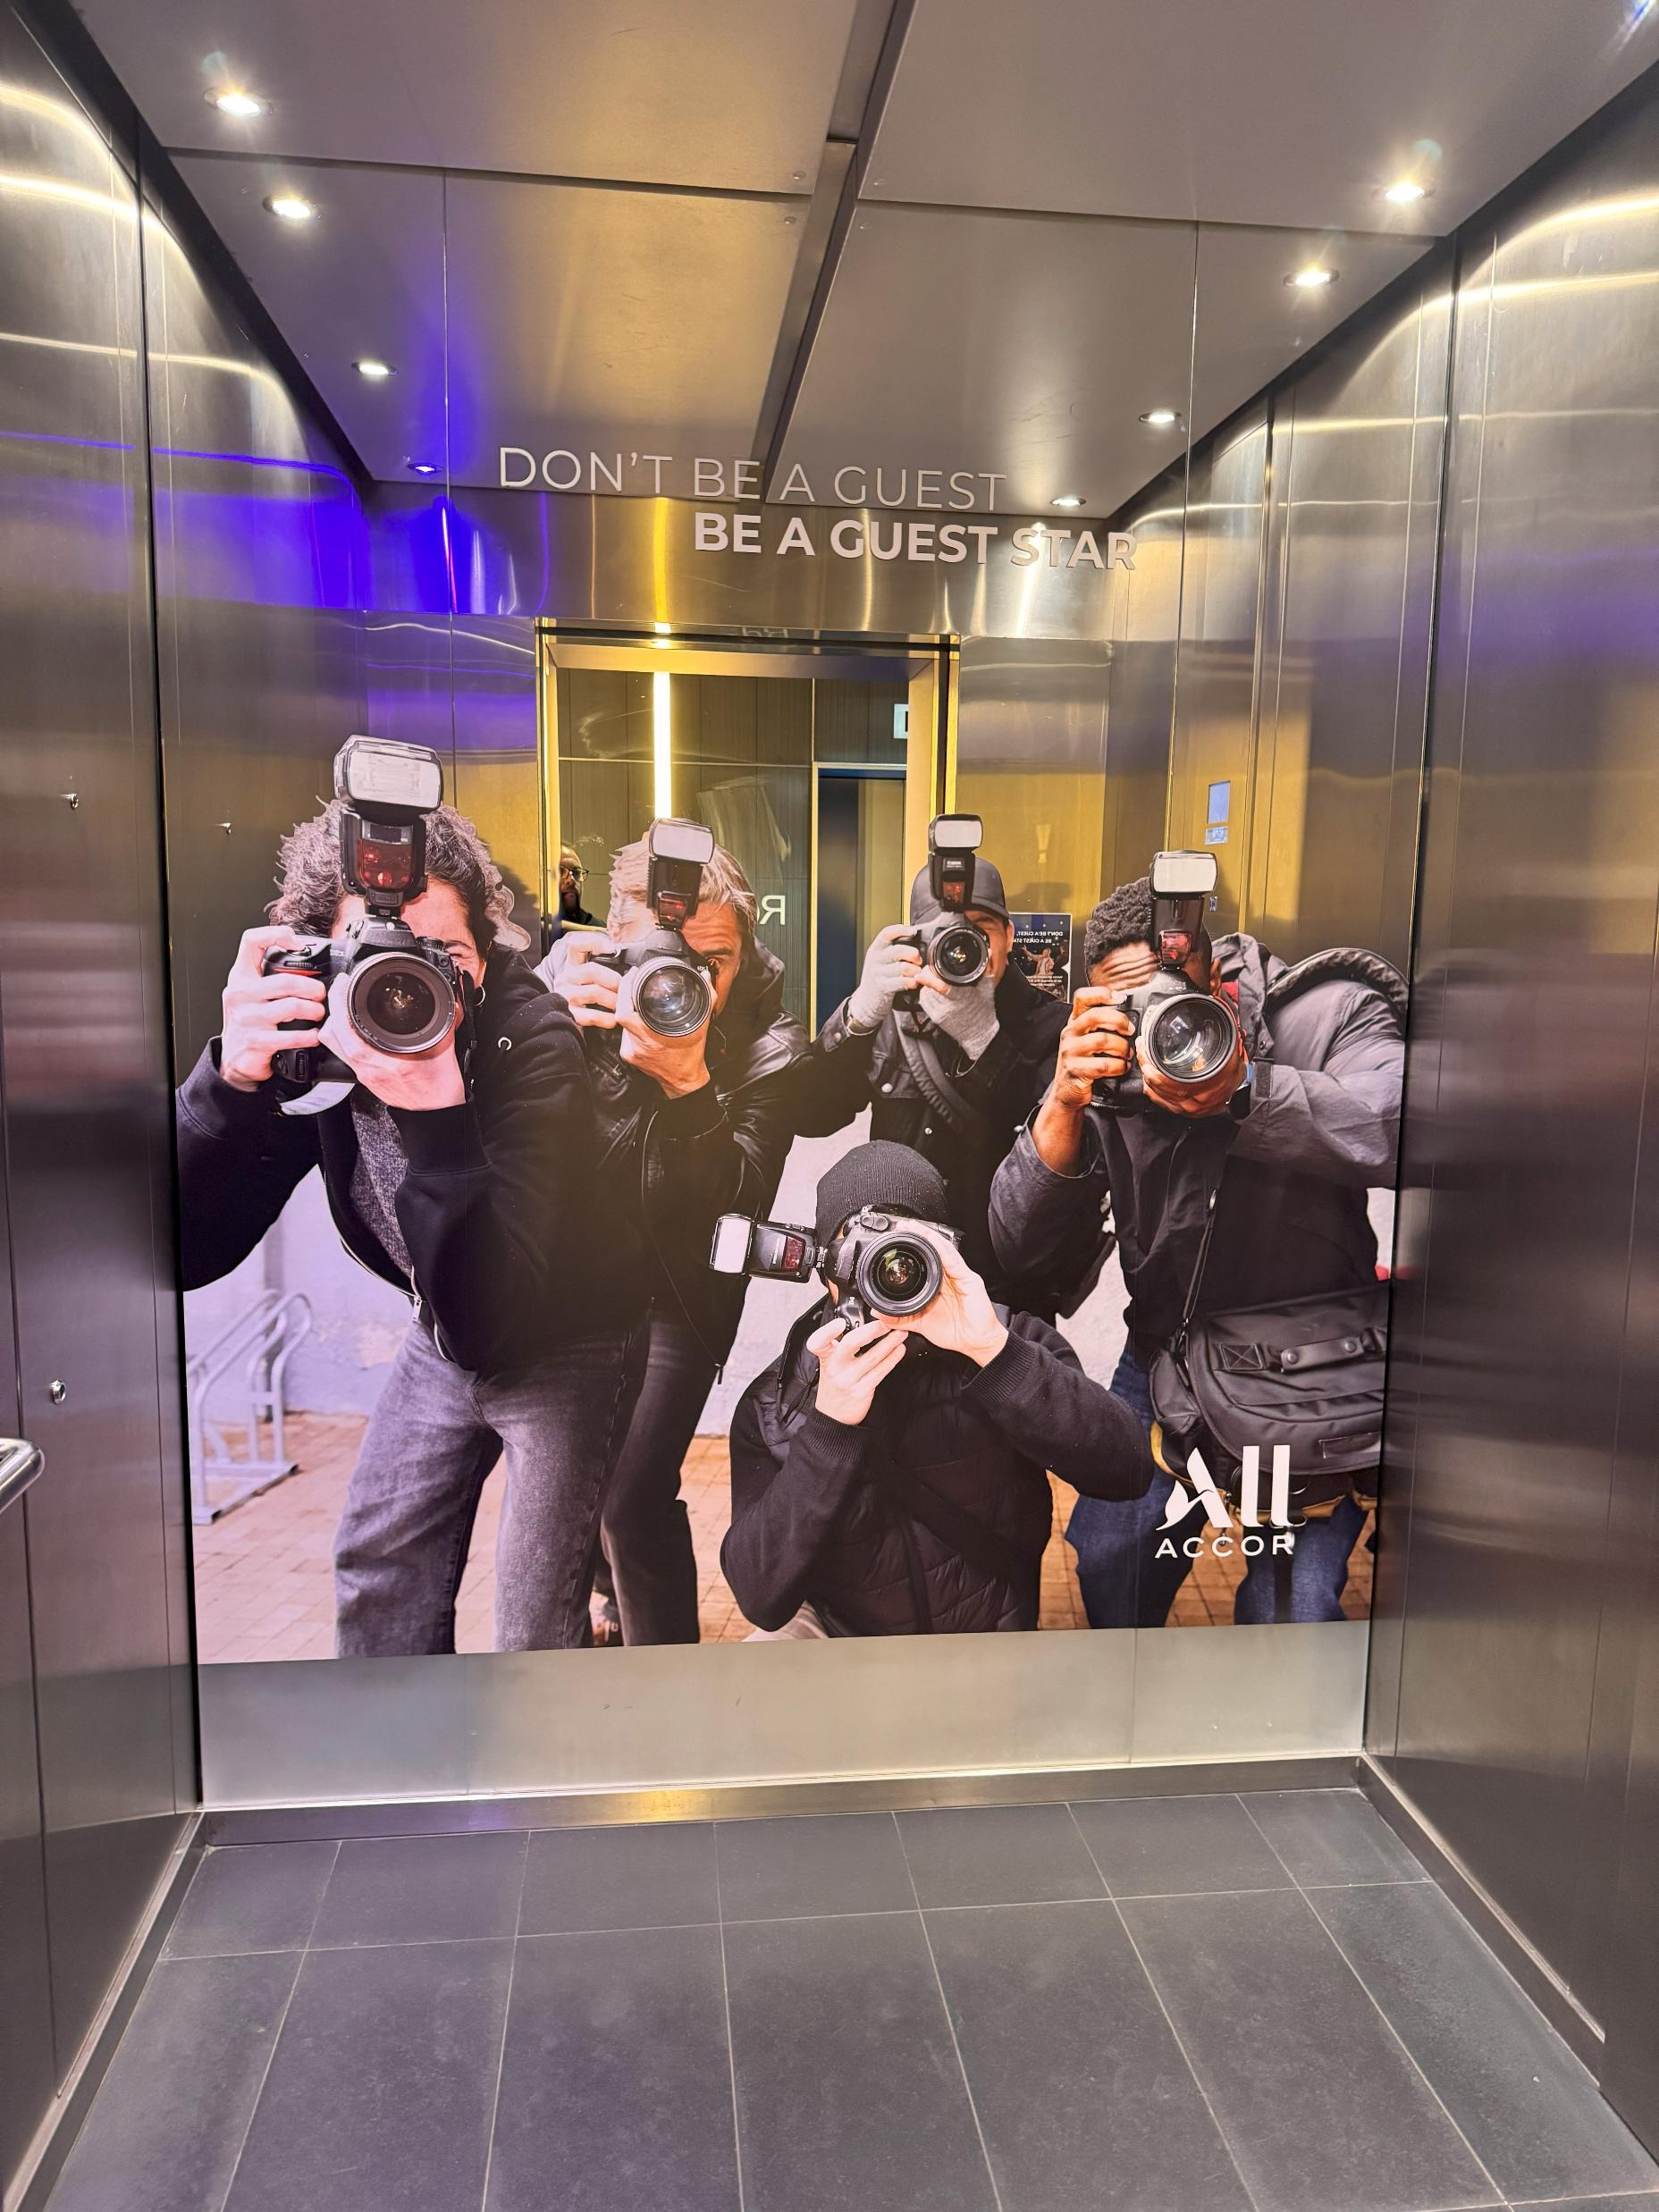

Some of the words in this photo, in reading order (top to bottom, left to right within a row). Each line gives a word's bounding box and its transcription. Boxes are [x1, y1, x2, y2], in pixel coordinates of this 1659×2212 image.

[694, 458, 761, 500] BE
[779, 463, 815, 502] A
[834, 466, 1007, 511] GUEST
[695, 512, 762, 553] BE
[776, 517, 815, 556] A
[830, 519, 998, 564] GUEST
[1010, 527, 1138, 570] STAR
[1154, 1535, 1294, 1560] ACCOR
